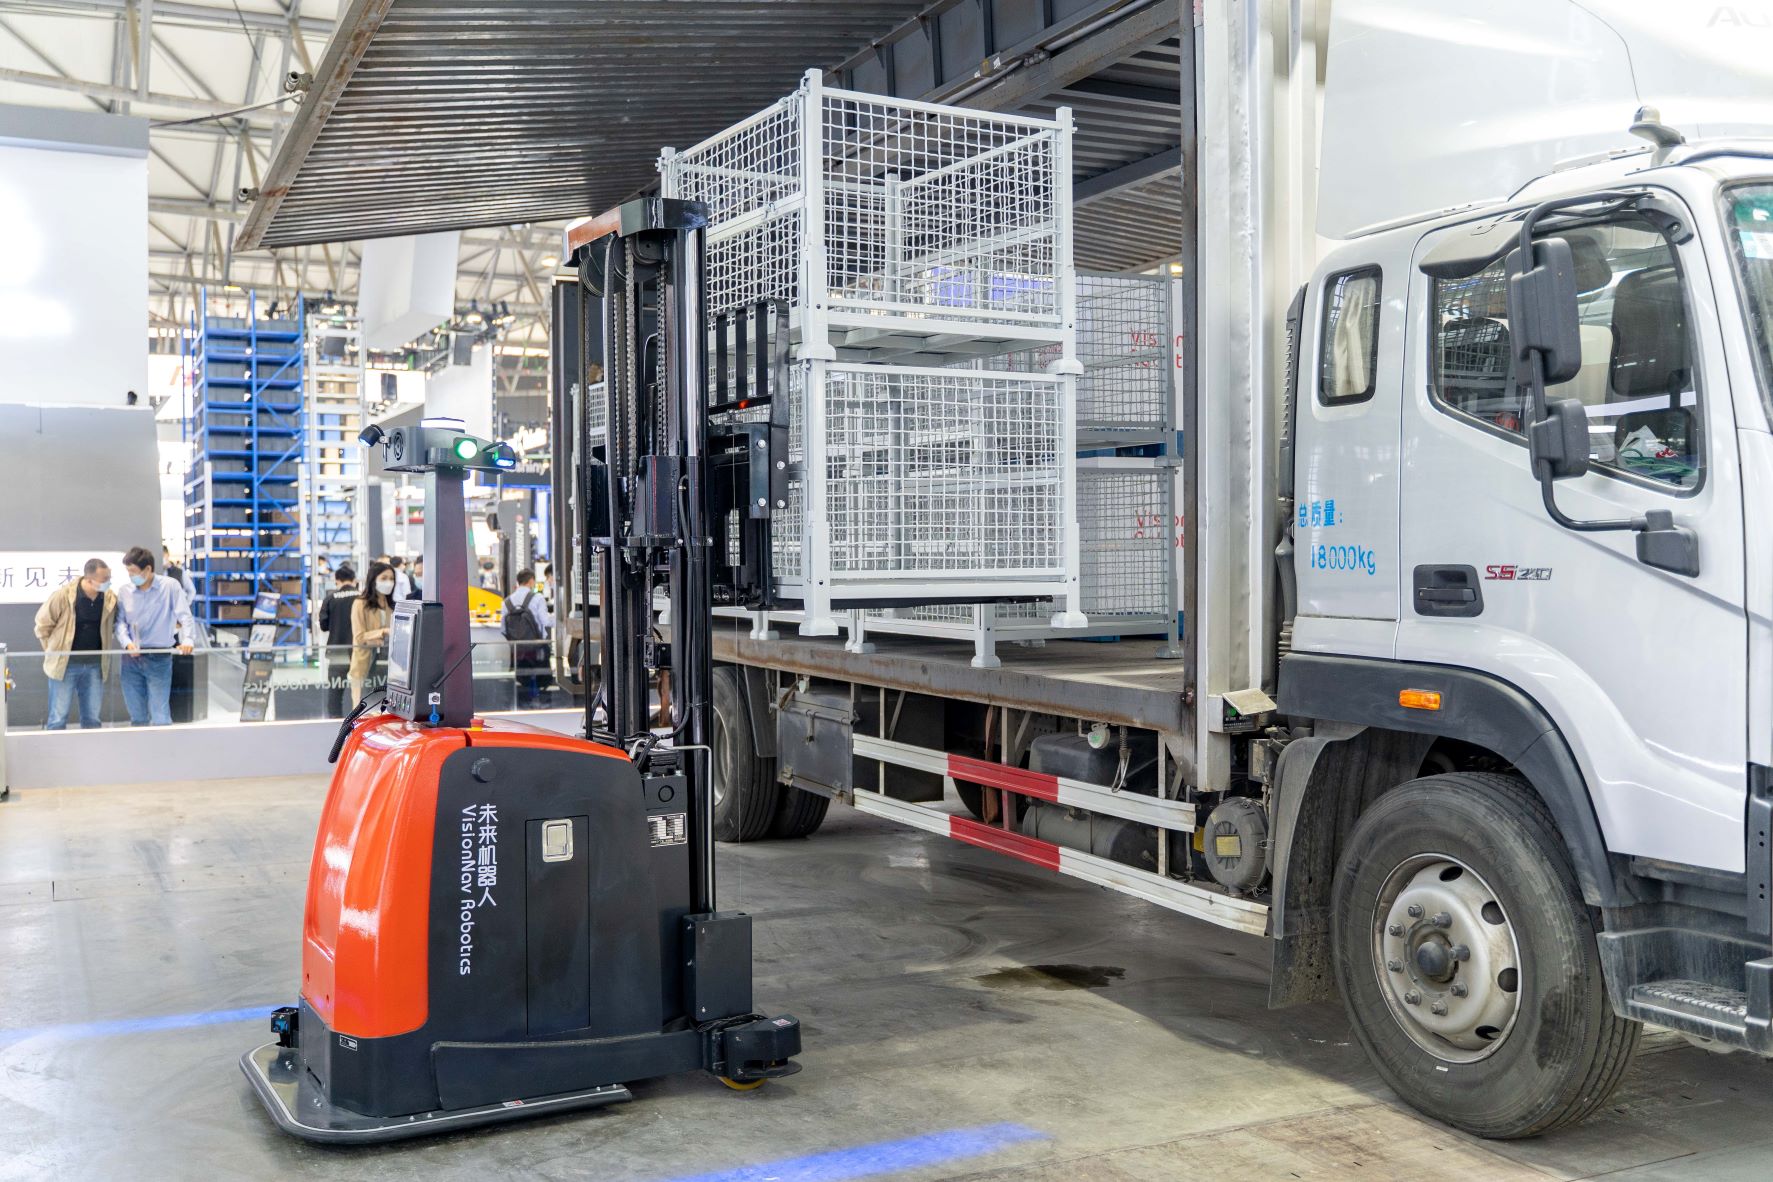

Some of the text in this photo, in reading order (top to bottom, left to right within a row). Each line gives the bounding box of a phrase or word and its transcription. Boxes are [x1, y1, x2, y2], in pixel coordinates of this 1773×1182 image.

[1311, 545, 1376, 575] 18000kg
[459, 804, 477, 976] VisionNav Robotics
[477, 803, 498, 907] 未来机器人
